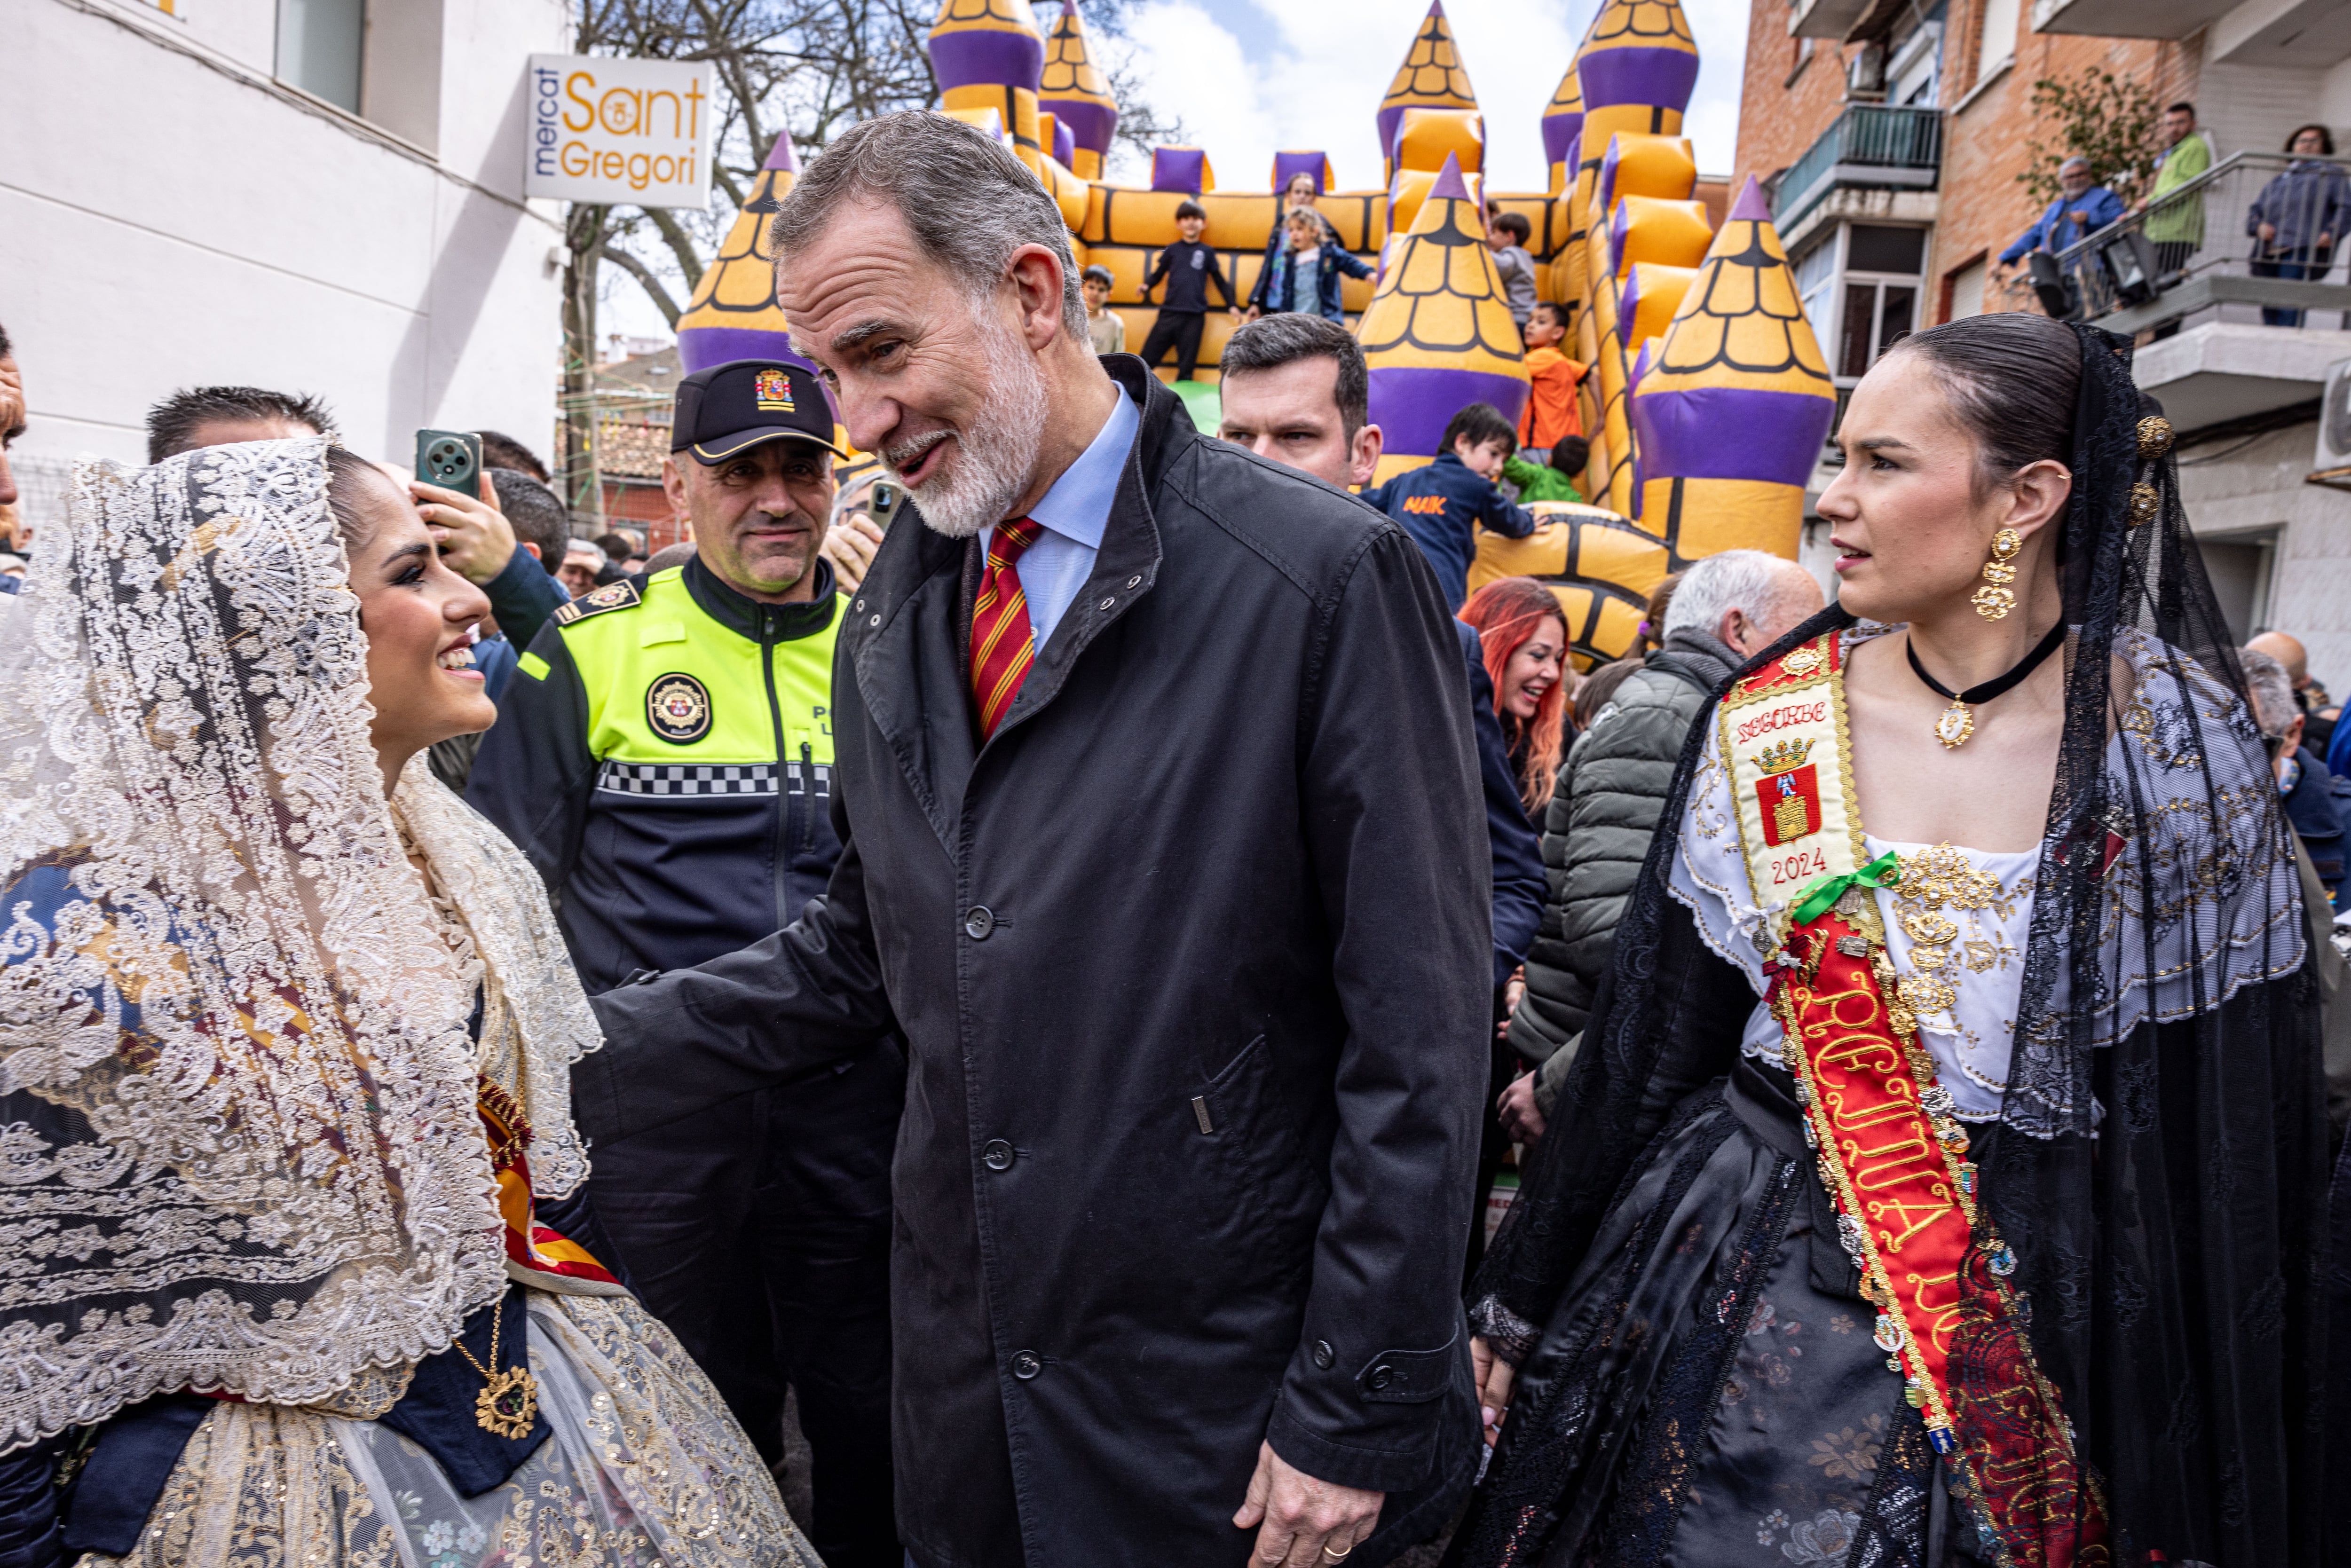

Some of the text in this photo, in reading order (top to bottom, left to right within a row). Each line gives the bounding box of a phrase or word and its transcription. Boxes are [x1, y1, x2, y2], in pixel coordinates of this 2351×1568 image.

[535, 68, 559, 176] mercat
[562, 71, 705, 140] Sant
[560, 141, 695, 190] Gregori
[813, 706, 831, 719] P
[1738, 702, 1826, 744] SEGORBE
[1772, 847, 1827, 884] 2024
[1794, 971, 1955, 1253] REINA
